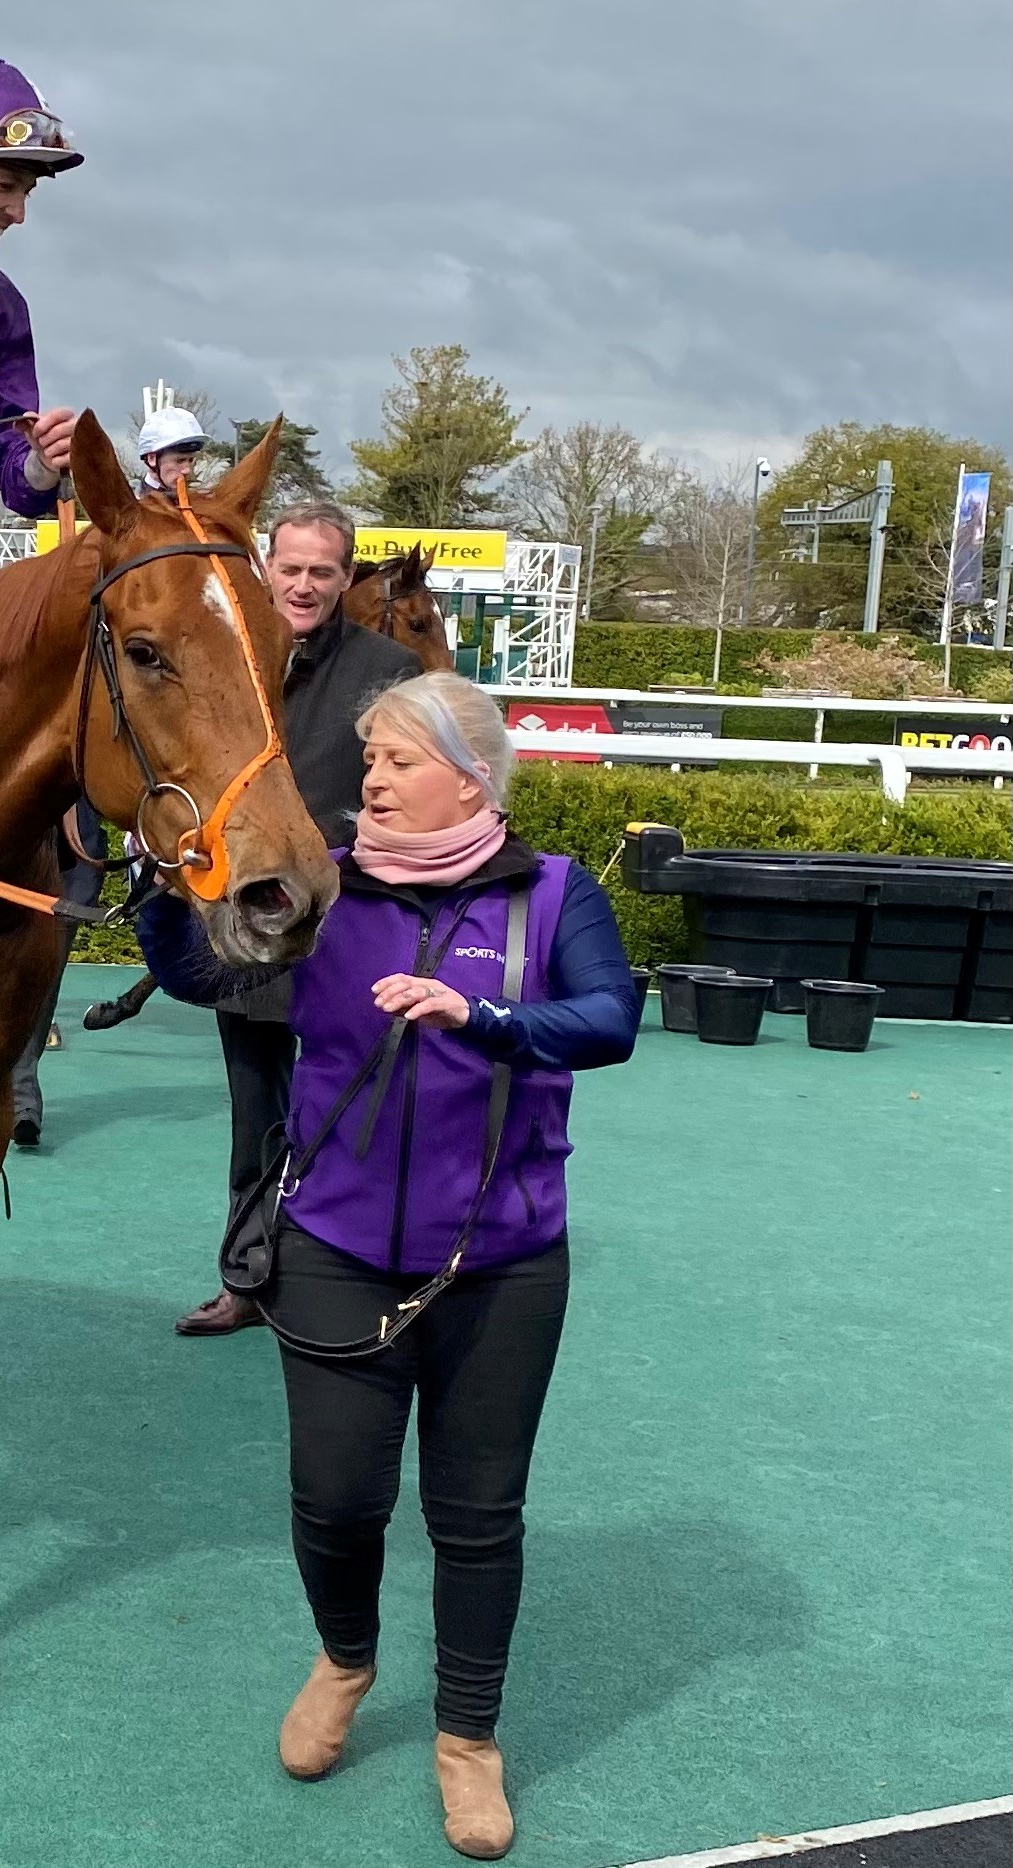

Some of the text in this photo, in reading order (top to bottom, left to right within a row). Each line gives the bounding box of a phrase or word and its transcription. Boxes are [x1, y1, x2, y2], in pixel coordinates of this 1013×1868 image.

[439, 542, 483, 559] Free
[634, 721, 651, 729] your
[670, 722, 688, 730] boss
[454, 946, 496, 960] SPORTS
